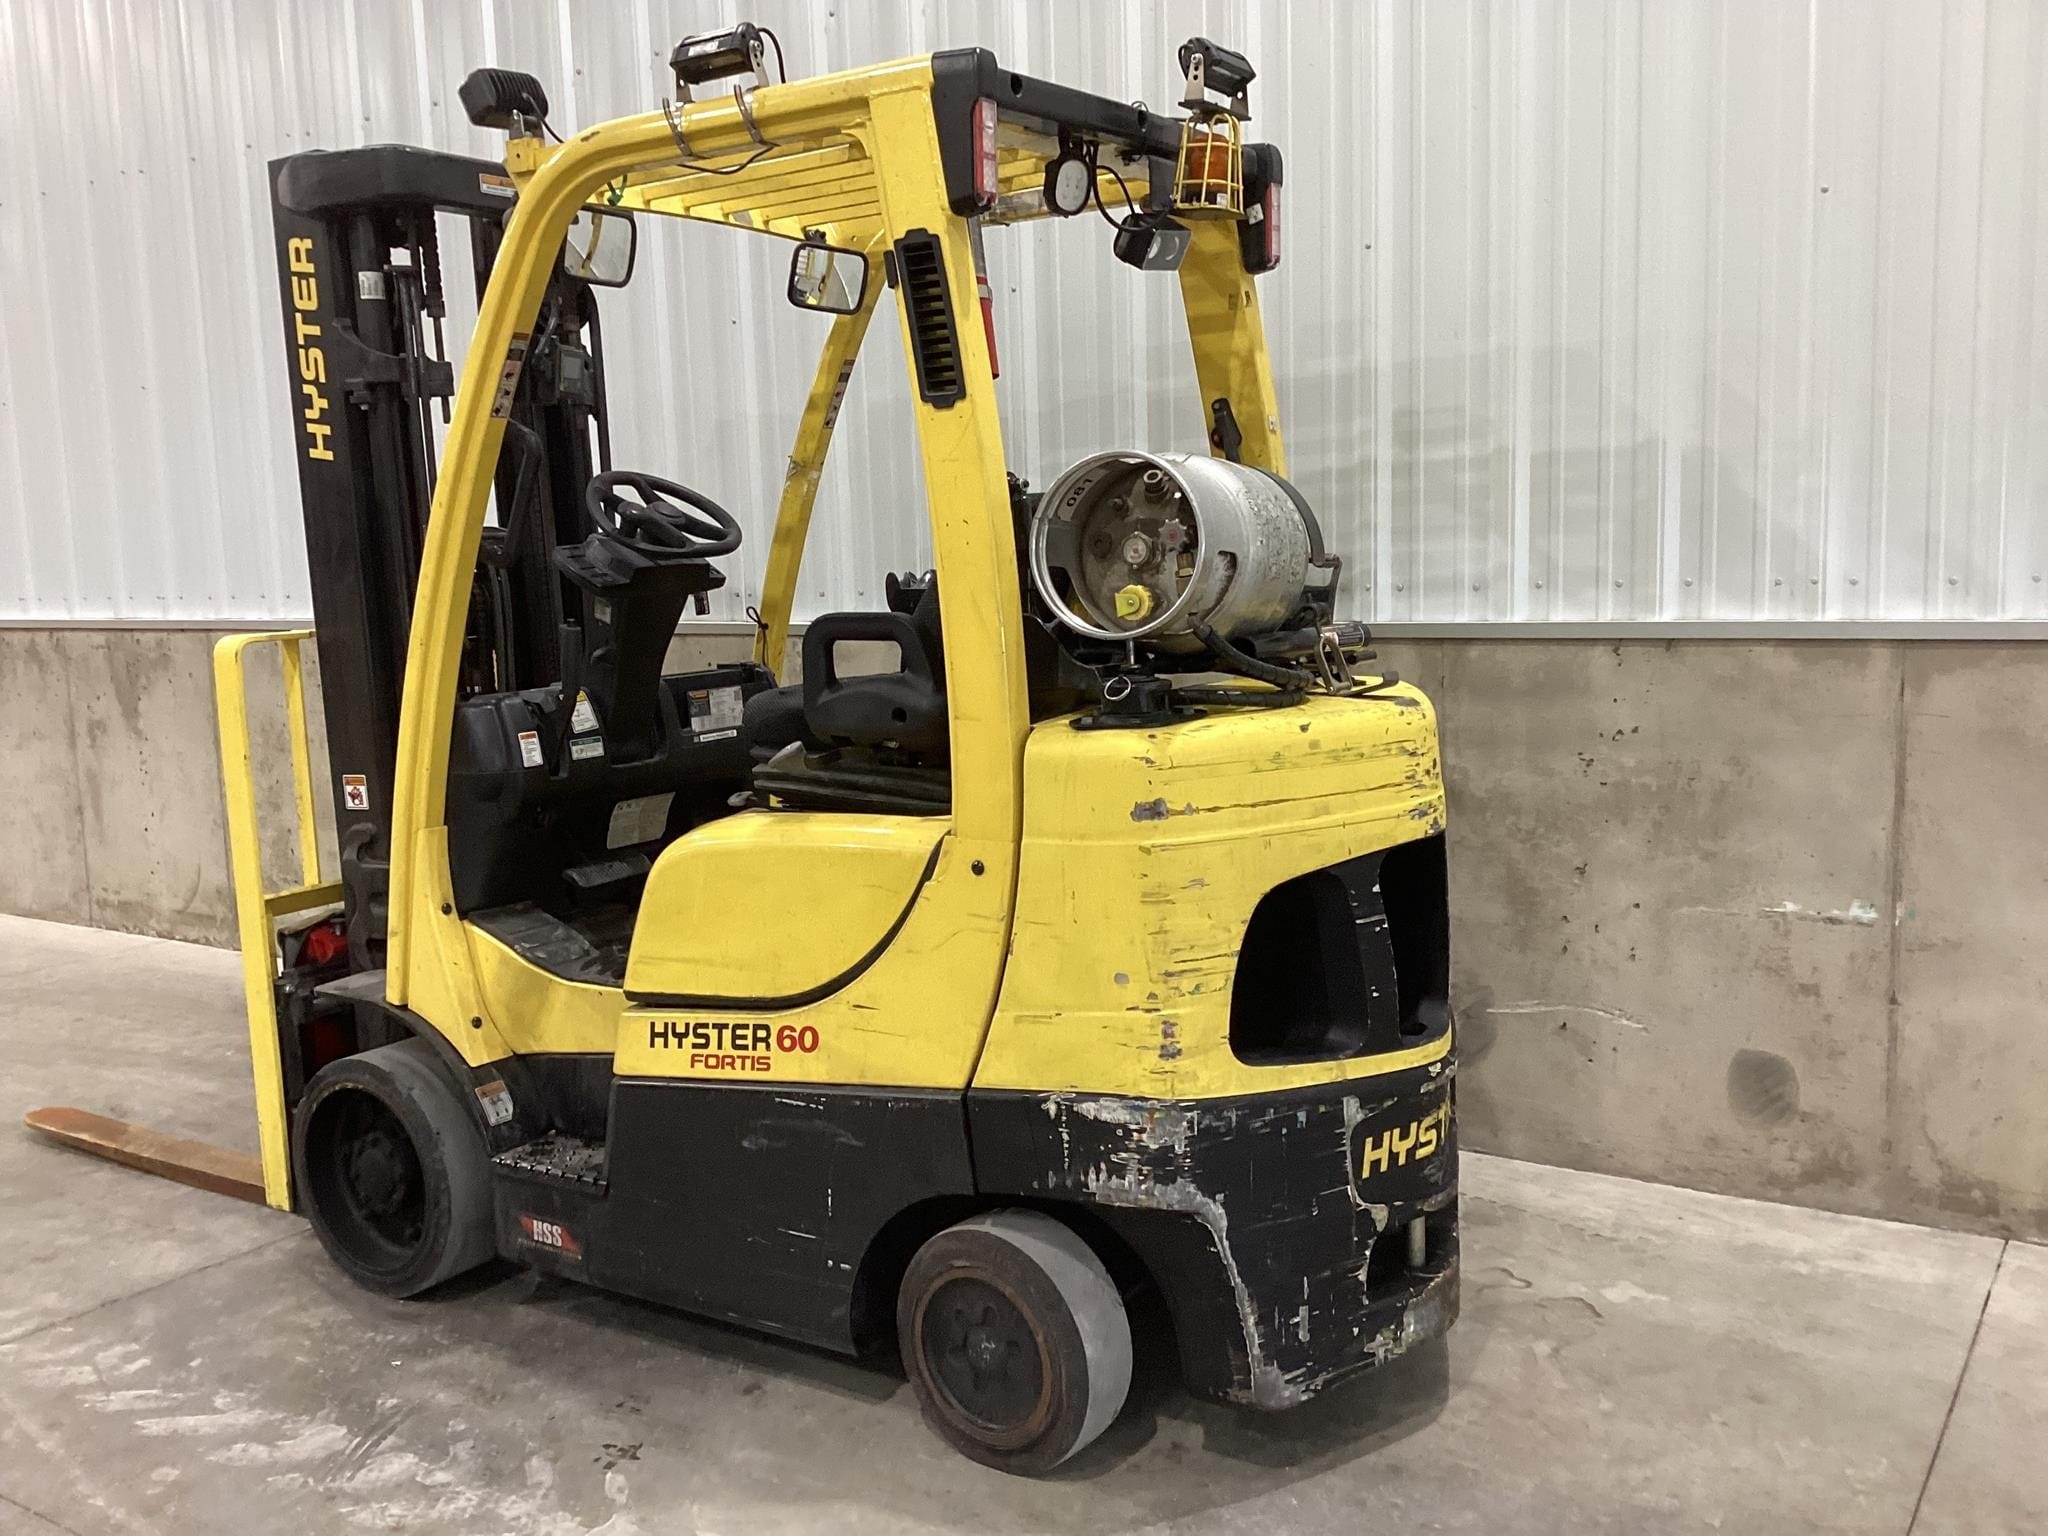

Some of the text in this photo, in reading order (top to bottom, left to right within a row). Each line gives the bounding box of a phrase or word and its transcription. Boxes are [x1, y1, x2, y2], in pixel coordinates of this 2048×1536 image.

[287, 236, 335, 461] HYSTER
[650, 1021, 819, 1053] HYSTER 60
[690, 1053, 771, 1072] FORTIS
[532, 1219, 562, 1247] HSS
